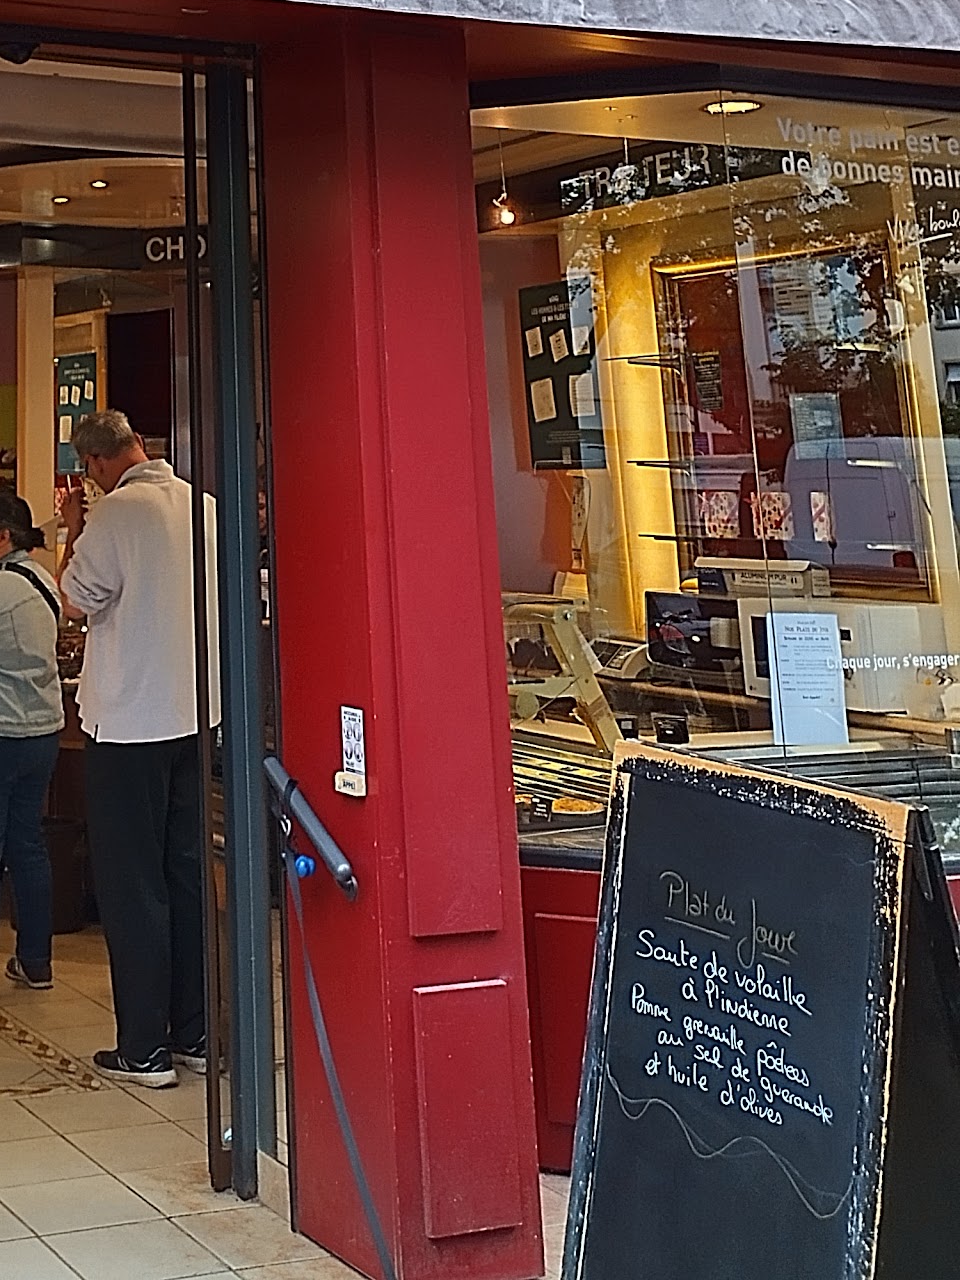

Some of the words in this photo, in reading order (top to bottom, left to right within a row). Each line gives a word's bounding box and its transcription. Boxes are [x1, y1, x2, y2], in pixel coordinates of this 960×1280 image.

[777, 116, 840, 146] Votre
[906, 133, 941, 155] est
[782, 151, 812, 176] de
[873, 654, 900, 671] jour,
[903, 653, 960, 670] s'engager
[659, 871, 709, 916] Plat
[715, 895, 735, 925] du
[682, 977, 698, 1001] à
[703, 951, 728, 983] de
[735, 963, 812, 1016] volaille
[645, 1051, 661, 1076] et
[668, 1055, 709, 1092] huile
[658, 1030, 684, 1047] au
[693, 1044, 724, 1069] sel
[731, 1057, 750, 1082] de
